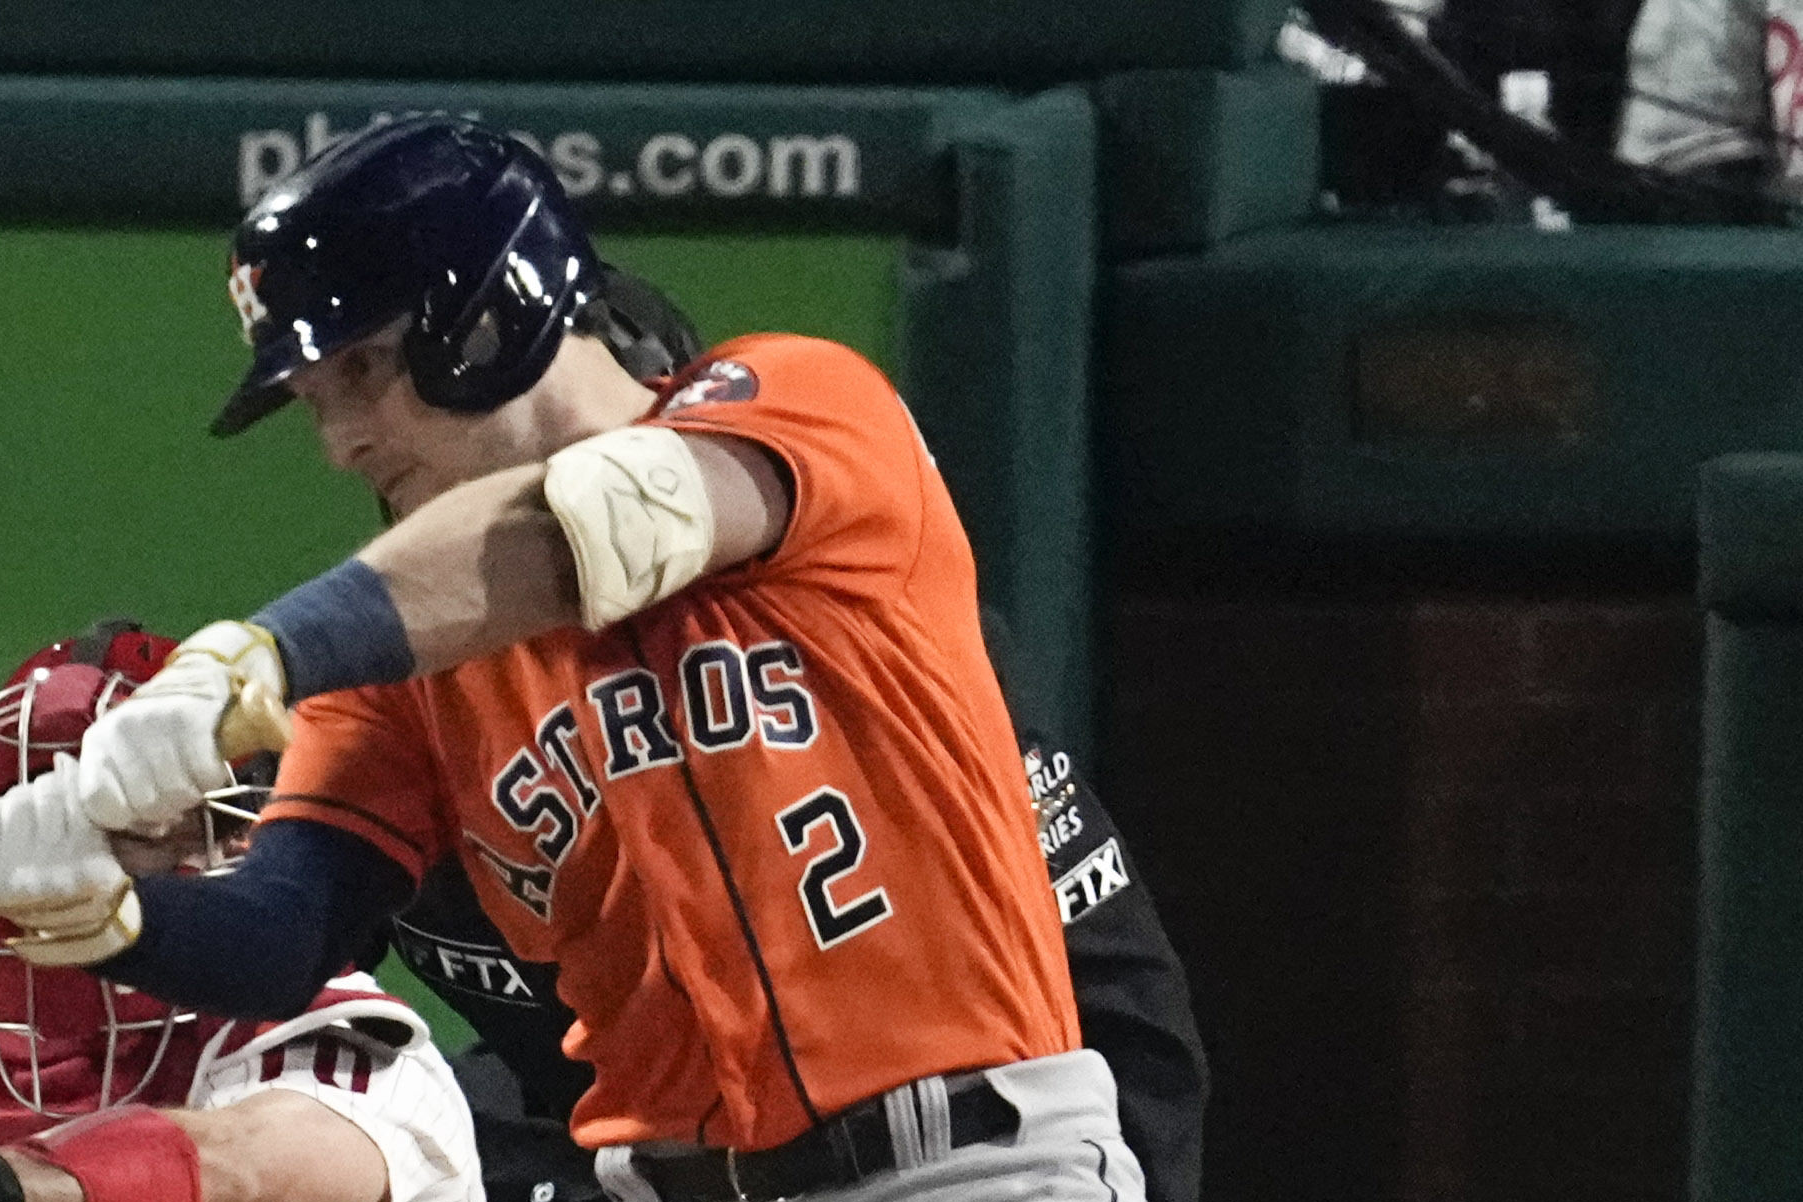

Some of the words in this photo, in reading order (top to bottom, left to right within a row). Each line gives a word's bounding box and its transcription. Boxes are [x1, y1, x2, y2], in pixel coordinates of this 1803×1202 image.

[462, 639, 820, 924] ASTROS
[775, 784, 894, 951] 2
[1055, 847, 1128, 924] FTX
[436, 945, 535, 998] FTX
